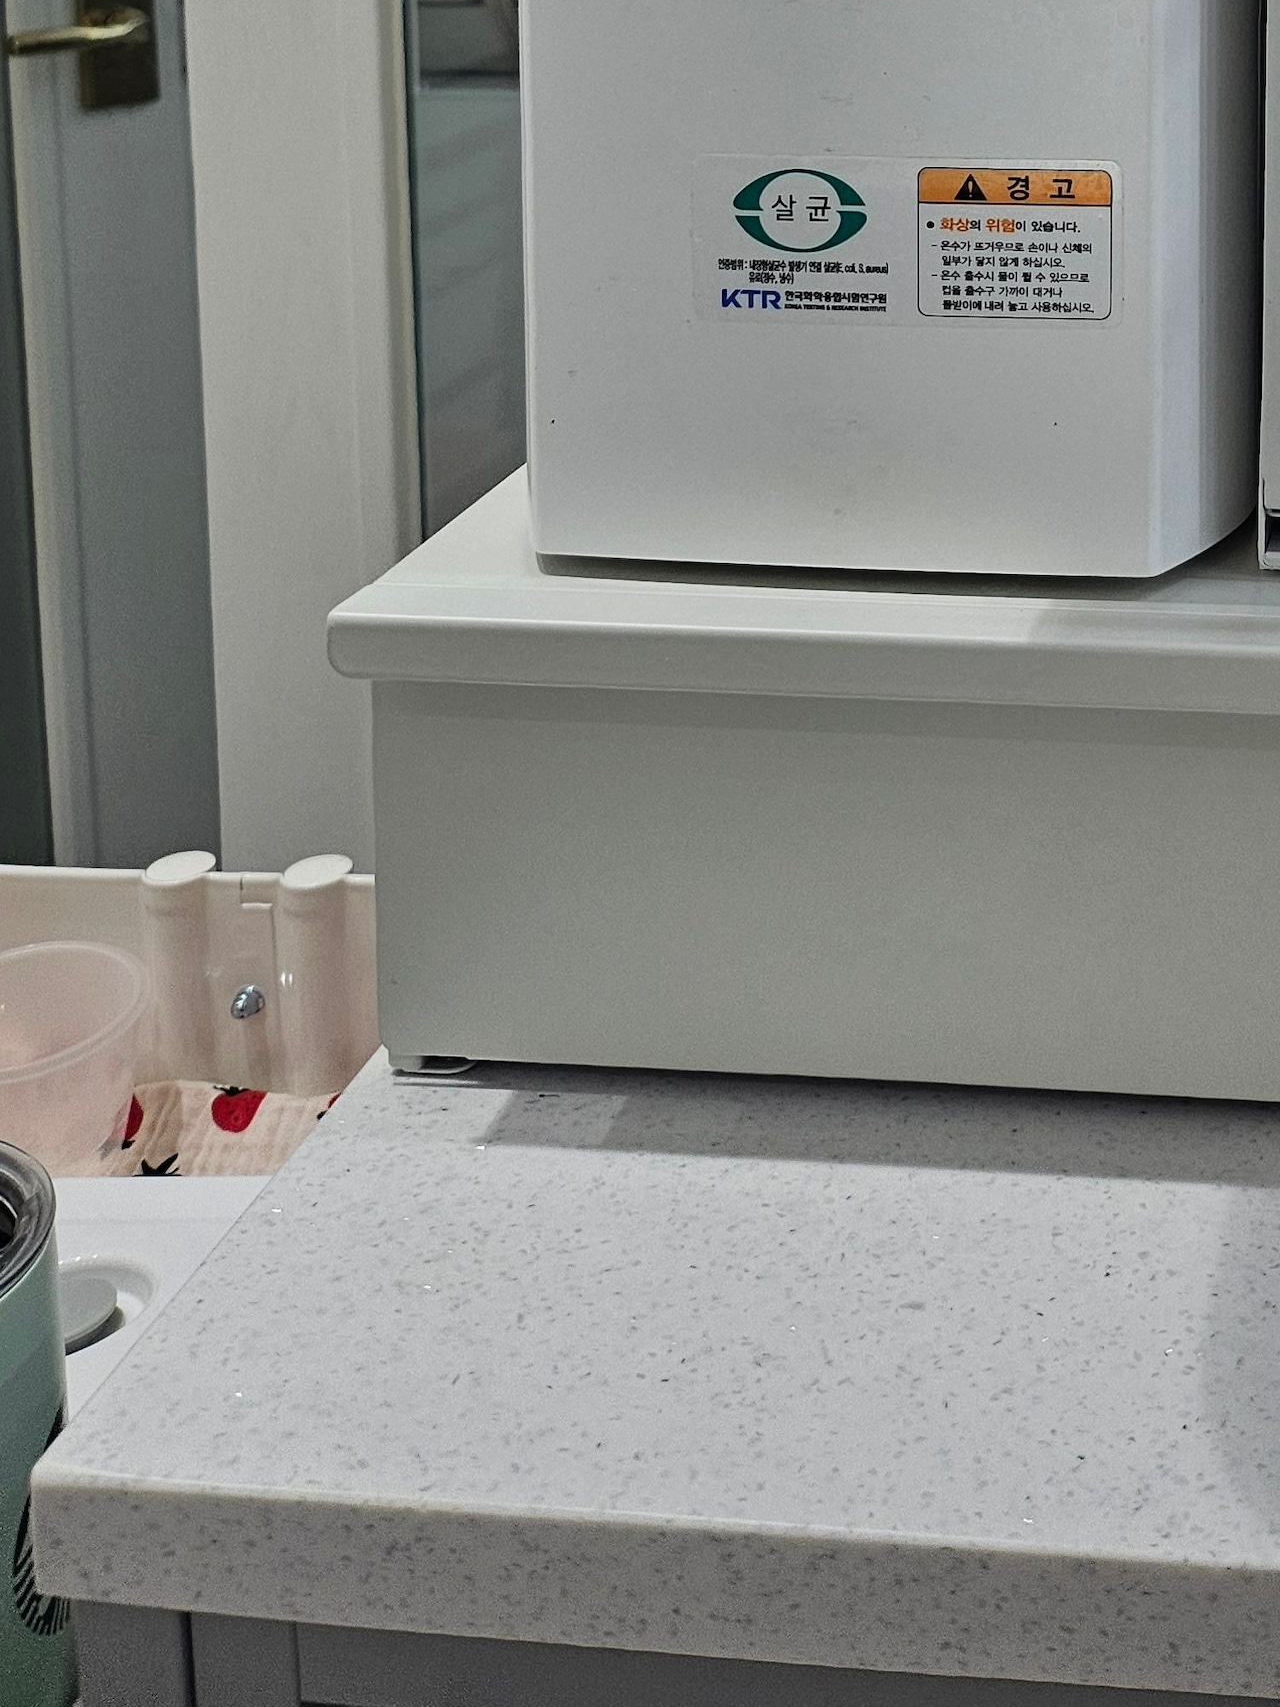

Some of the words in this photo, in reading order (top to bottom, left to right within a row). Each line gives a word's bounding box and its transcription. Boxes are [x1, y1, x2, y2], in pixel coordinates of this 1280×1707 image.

[939, 217, 981, 232] 화상의
[985, 217, 1026, 233] 위험이
[1031, 220, 1081, 233] 있습니다.
[940, 240, 971, 252] 온수가
[973, 241, 1025, 252] 뜨거우므로
[1028, 242, 1058, 253] 손이나
[1061, 243, 1092, 254] 신체의
[941, 255, 972, 267] 일부가
[1022, 257, 1066, 268] 하십시오.
[940, 270, 961, 281] 온수
[1035, 272, 1046, 283] 수
[1049, 272, 1090, 284] 있으므로
[721, 288, 782, 309] KTR
[998, 286, 1029, 297] 가까이
[1032, 287, 1063, 298] 대거나
[1031, 301, 1095, 313] 사용하십시오.
